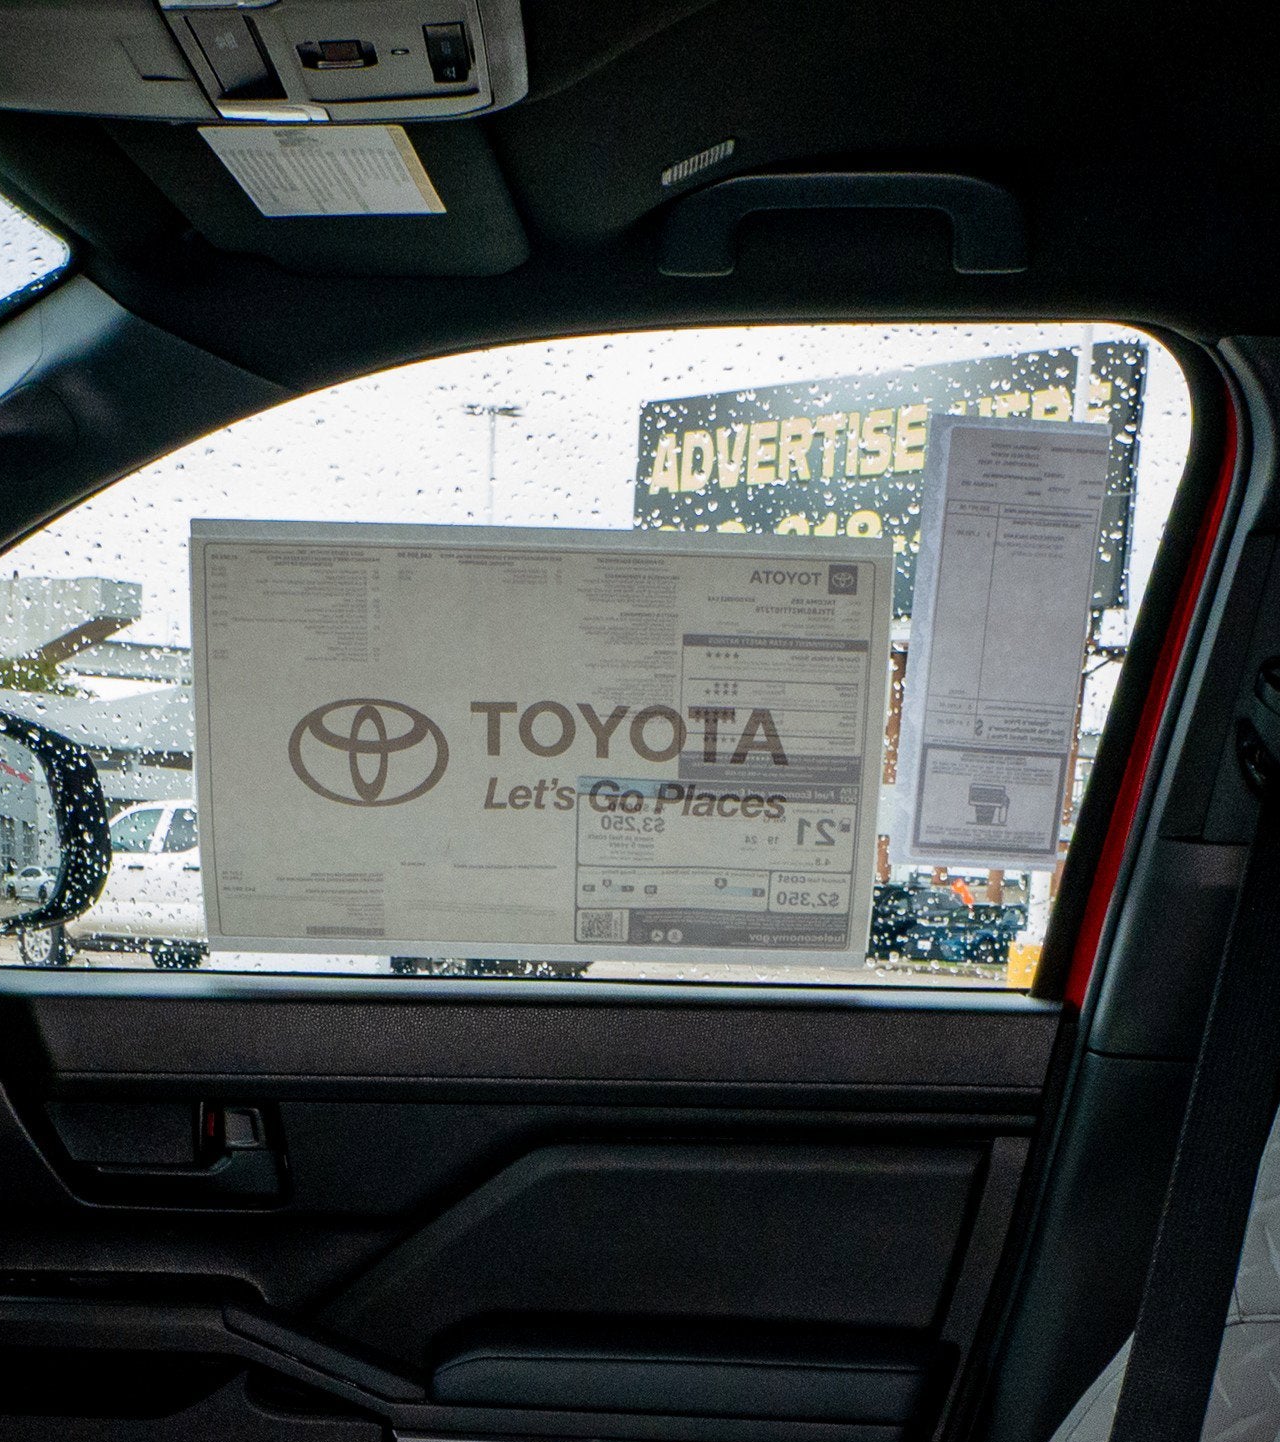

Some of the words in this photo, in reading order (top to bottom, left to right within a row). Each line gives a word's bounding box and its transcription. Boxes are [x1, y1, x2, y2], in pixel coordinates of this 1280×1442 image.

[649, 403, 929, 496] ADVERTISE
[471, 700, 789, 767] TOYOTA
[483, 778, 577, 813] Let's
[588, 780, 658, 815] Go
[662, 778, 788, 821] Places
